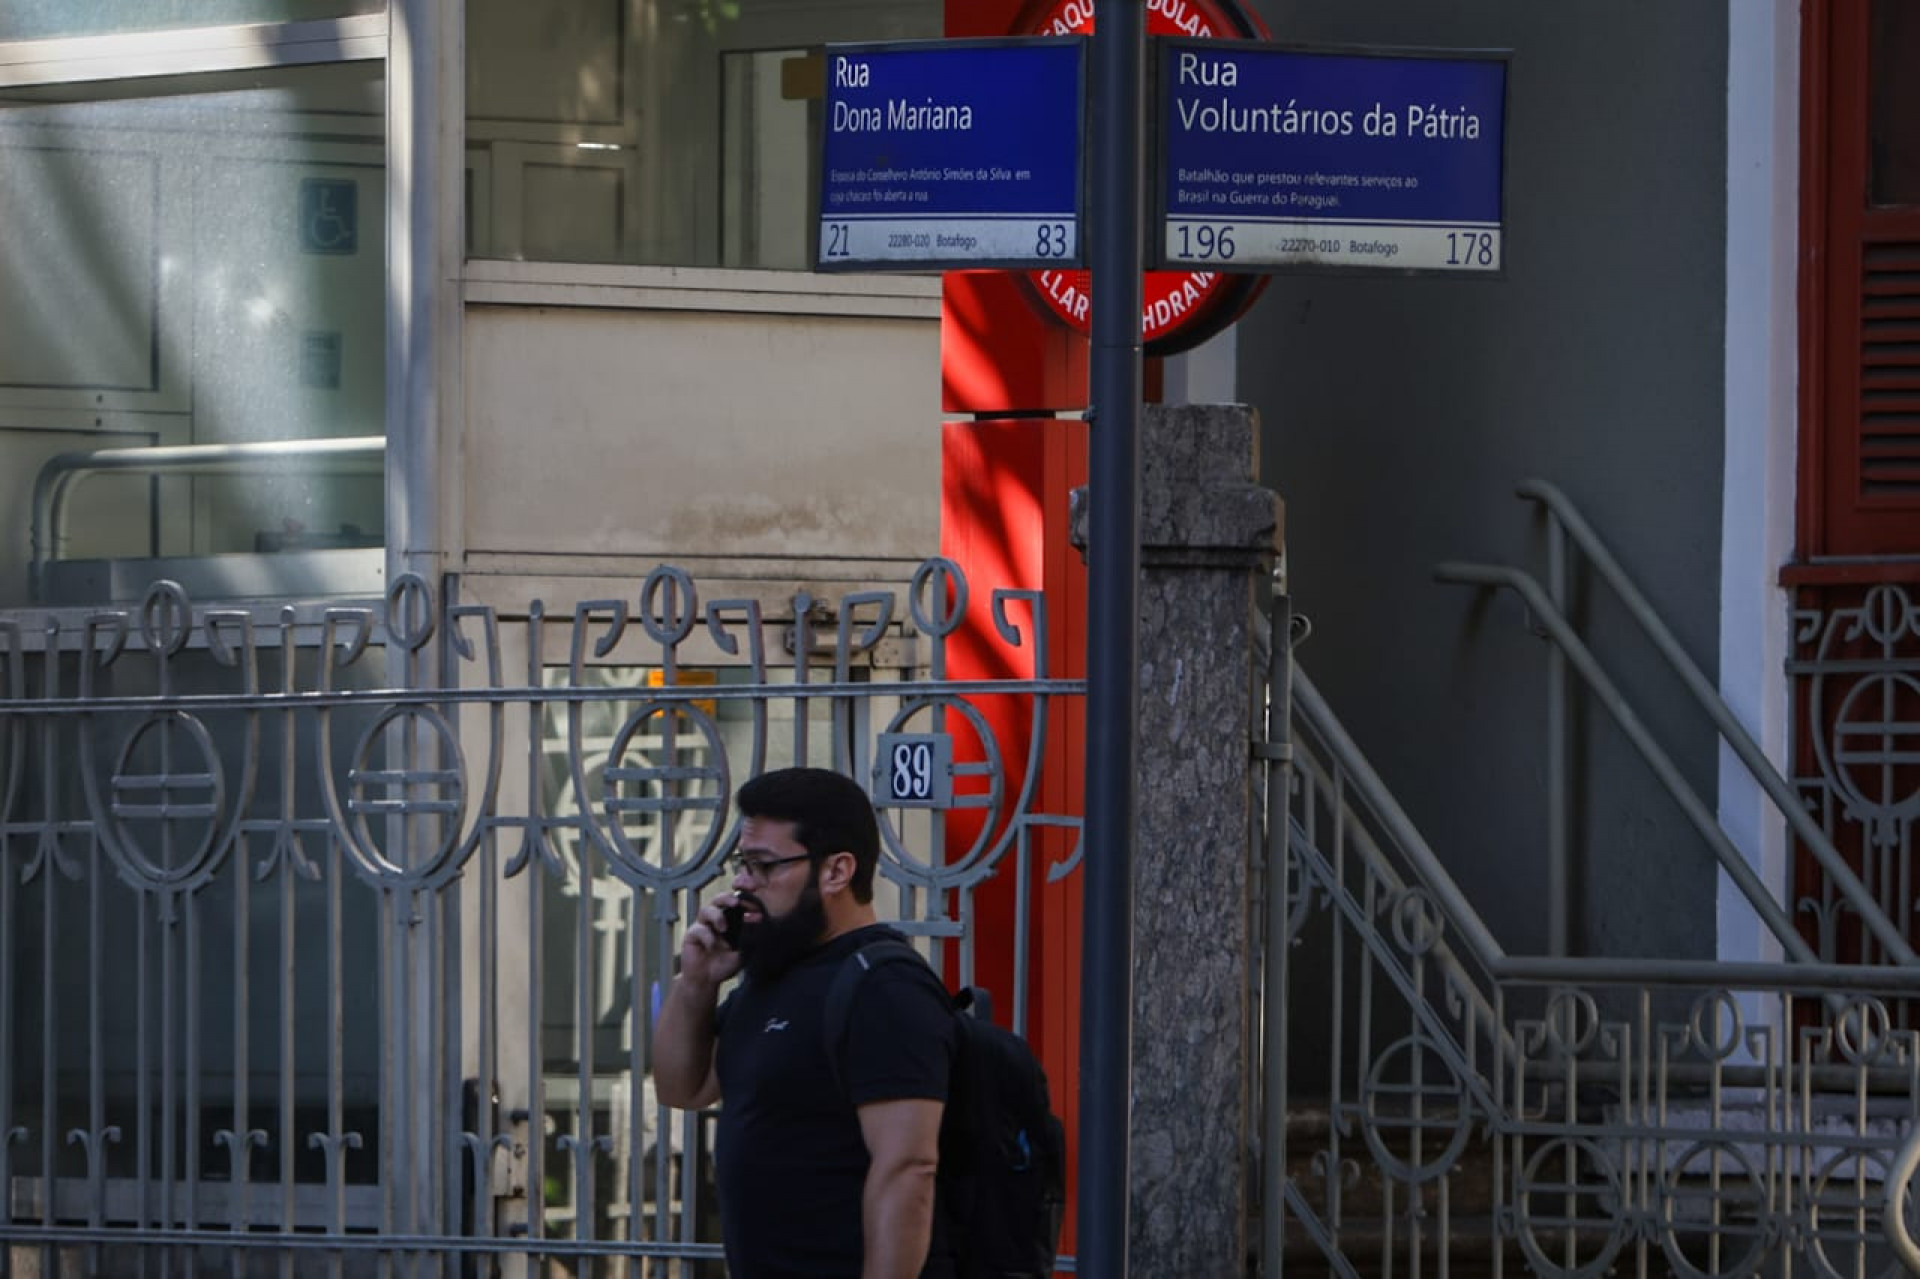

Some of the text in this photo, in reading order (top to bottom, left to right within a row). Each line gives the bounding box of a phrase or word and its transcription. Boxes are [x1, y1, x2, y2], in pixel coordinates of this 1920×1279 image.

[1043, 0, 1094, 37] AQU
[836, 56, 870, 88] Rua
[1179, 53, 1238, 87] Rua
[833, 96, 973, 133] Dona Mariana
[1177, 97, 1481, 139] Voluntários da Pátria
[989, 167, 1012, 181] Silva
[1178, 168, 1419, 190] Batalhão que prestou relevantes serviços ao
[1178, 189, 1209, 204] Brasil
[1211, 192, 1227, 204] na
[1229, 191, 1270, 205] Guerra
[1271, 191, 1288, 205] do
[827, 224, 850, 256] 21
[936, 233, 977, 251] Botafogo
[1036, 224, 1066, 257] 83
[1178, 225, 1493, 266] 196 22270-010 Botafogo 178
[893, 744, 931, 797] 89
